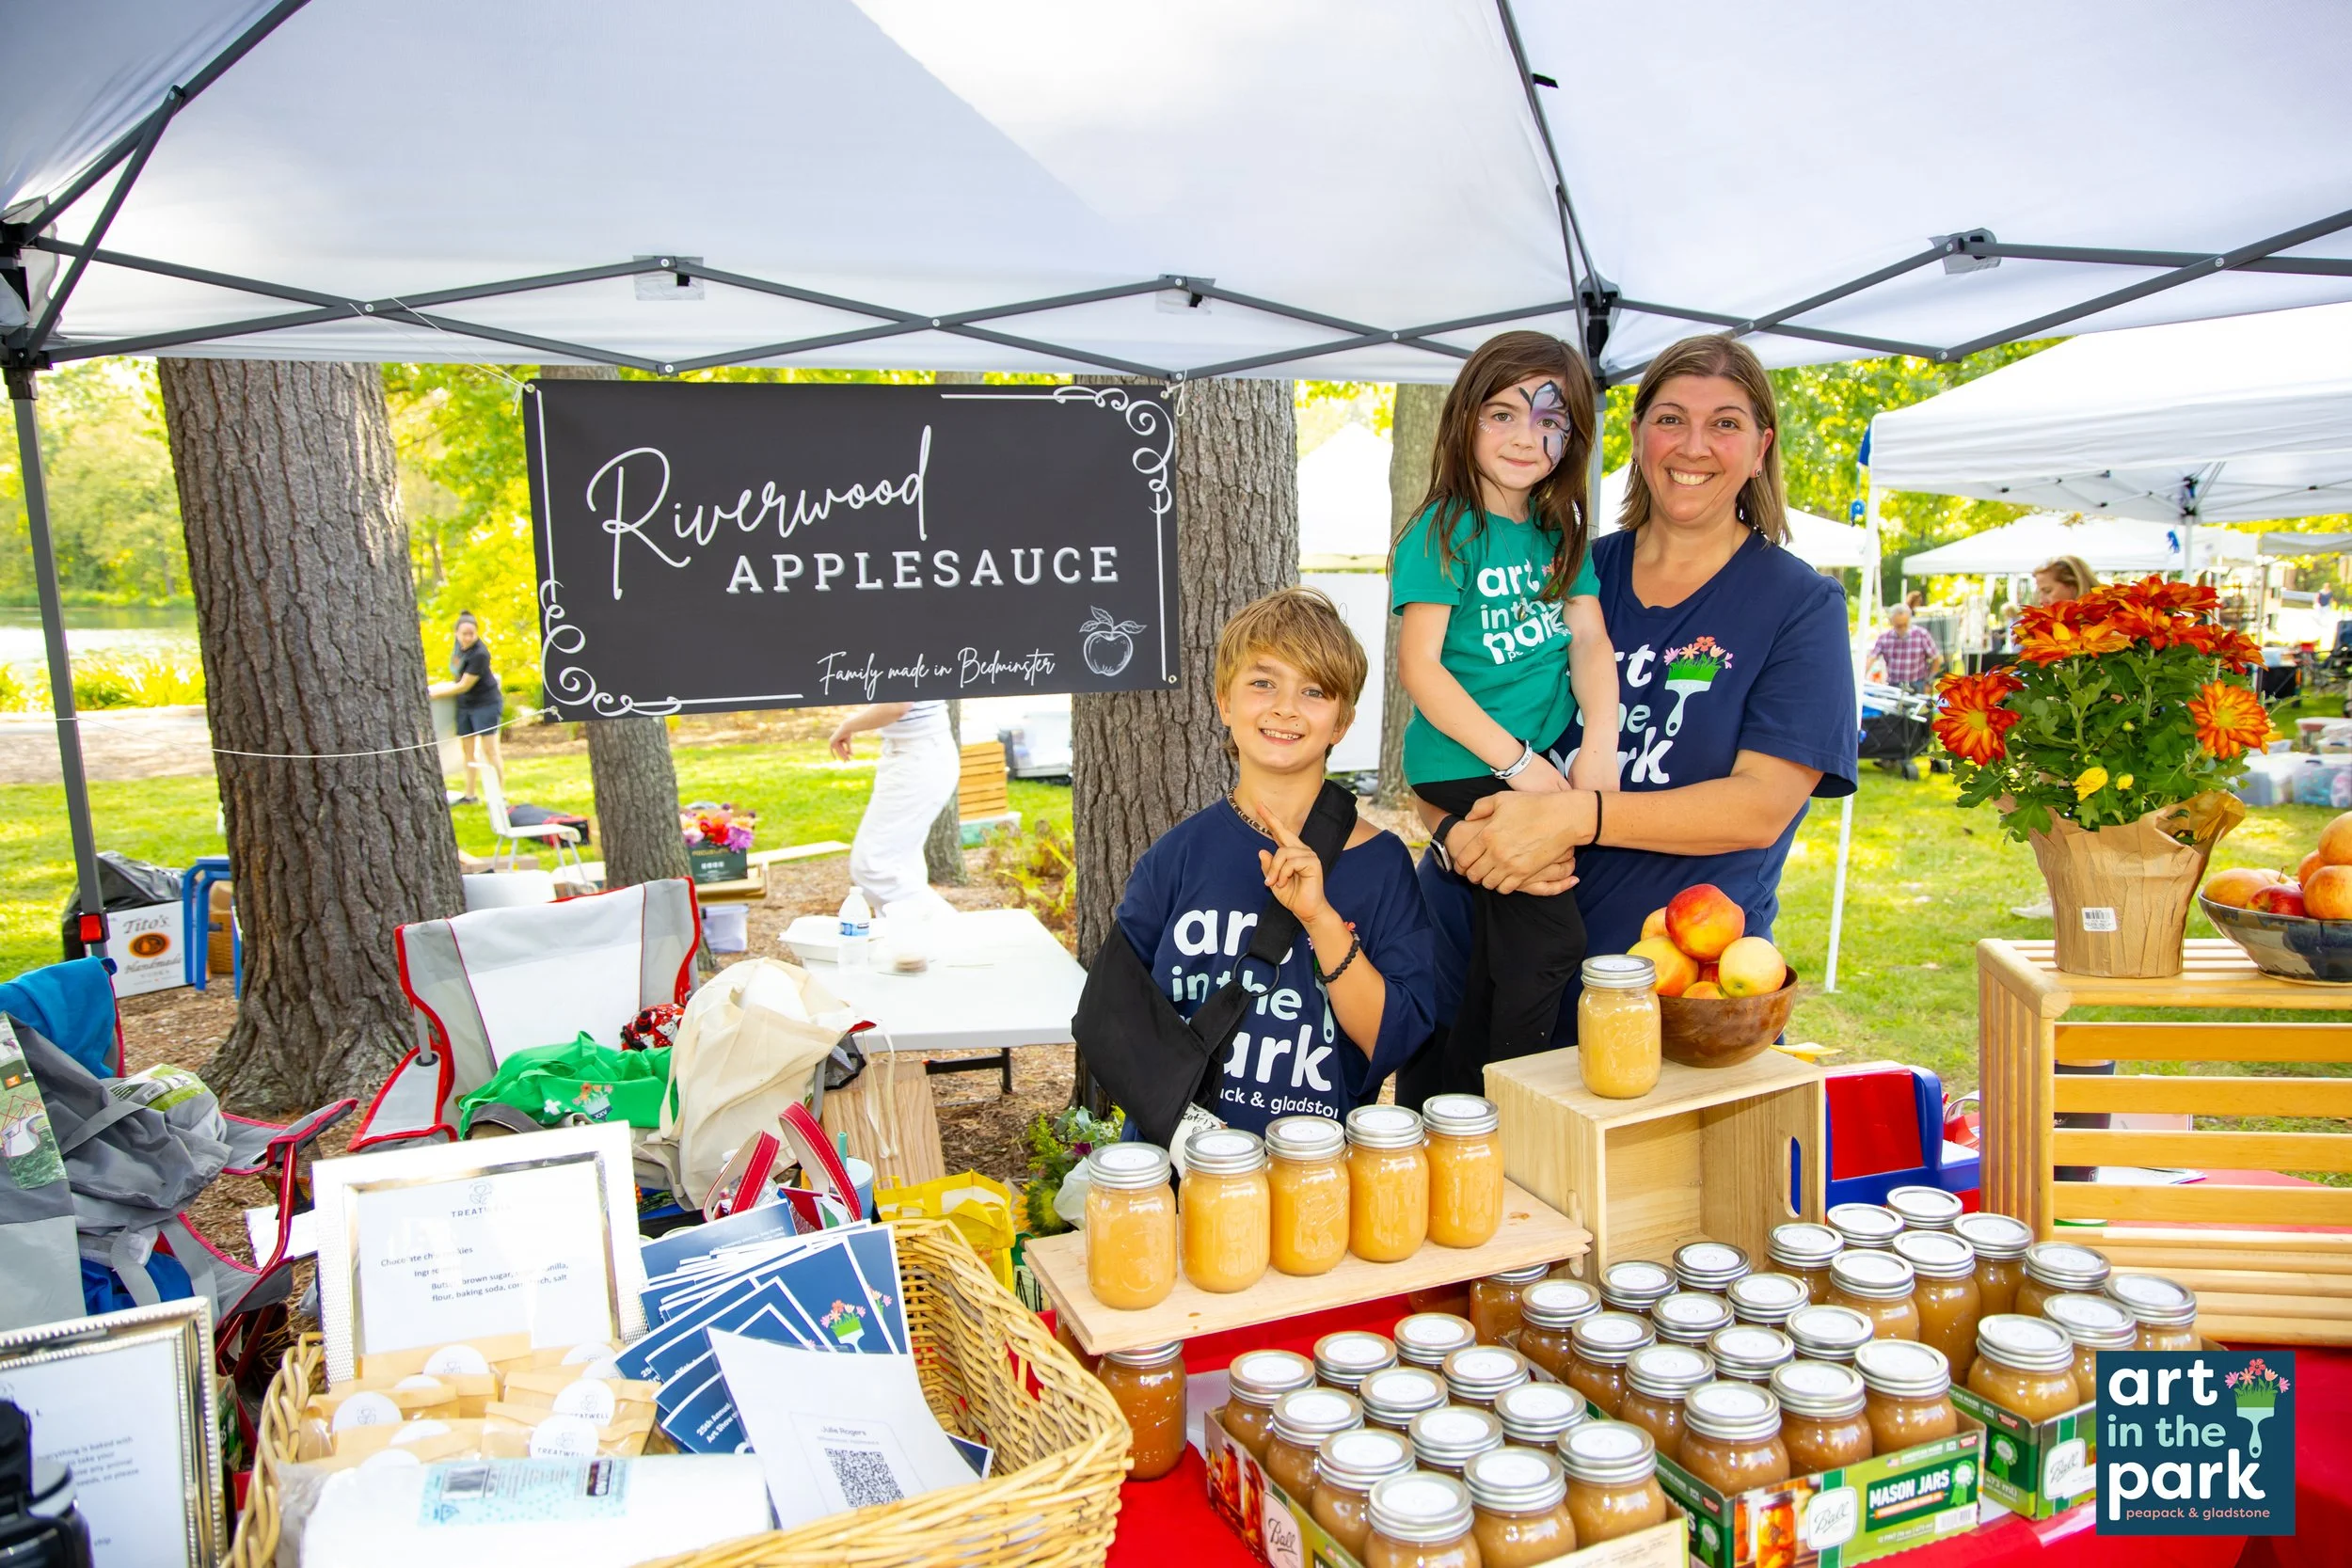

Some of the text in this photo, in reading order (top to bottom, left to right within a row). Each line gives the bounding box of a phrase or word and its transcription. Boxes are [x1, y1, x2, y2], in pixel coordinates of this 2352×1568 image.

[586, 425, 931, 600] Riverwood
[725, 546, 1120, 595] APPLESAUCE
[1476, 558, 1540, 597] art
[1480, 604, 1510, 630] in
[817, 648, 1057, 701] Family made in Bedminster
[122, 914, 170, 934] Tito's
[1171, 965, 1210, 1004] in
[1222, 1023, 1333, 1092] ark
[1249, 1090, 1266, 1108] &
[380, 1252, 421, 1268] Chocoate
[461, 1275, 488, 1286] brown
[489, 1270, 514, 1282] sugar,
[540, 1261, 569, 1274] anilla,
[431, 1291, 454, 1303] flour,
[455, 1288, 484, 1300] baking
[485, 1283, 506, 1294] soda,
[553, 1274, 568, 1283] salt
[696, 1417, 714, 1437] 25th
[706, 1429, 721, 1444] Art
[716, 1415, 735, 1436] Show
[536, 1447, 585, 1458] TREATWE
[2049, 1450, 2079, 1485] Ball
[1868, 1479, 1916, 1510] MASON
[1917, 1467, 1950, 1495] JARS
[1267, 1517, 1295, 1550] Ball
[1814, 1500, 1851, 1535] Ball
